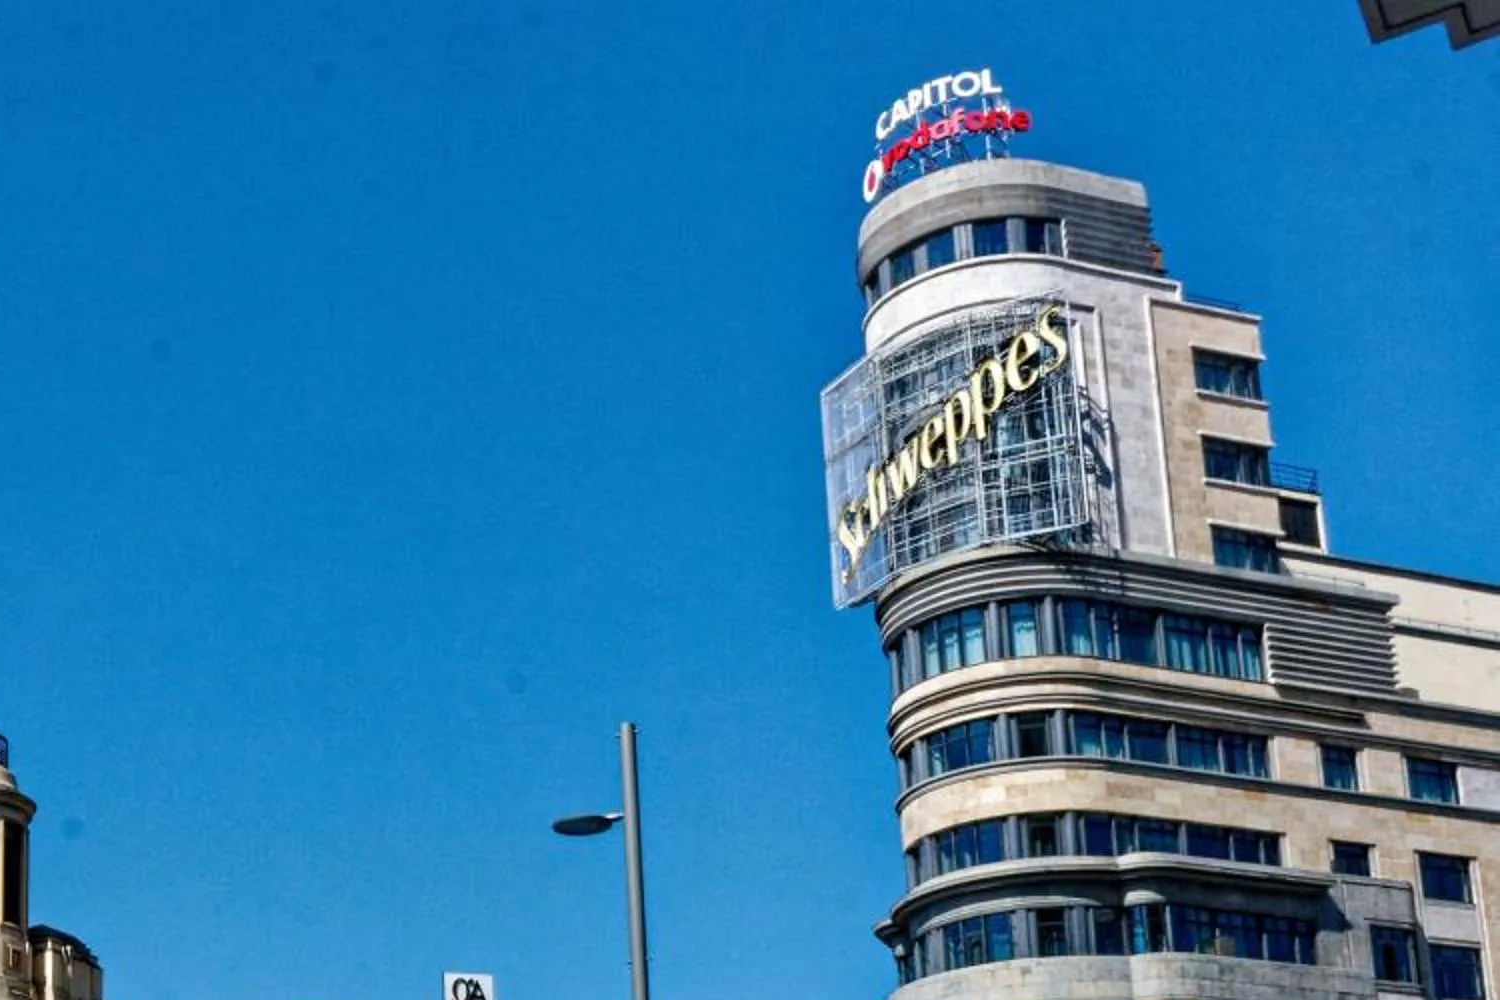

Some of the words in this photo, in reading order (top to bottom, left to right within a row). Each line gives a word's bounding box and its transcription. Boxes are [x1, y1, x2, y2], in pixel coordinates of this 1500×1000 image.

[875, 67, 1003, 141] CAPITOL
[882, 106, 1032, 174] vodafone
[836, 302, 1068, 584] Schweppes
